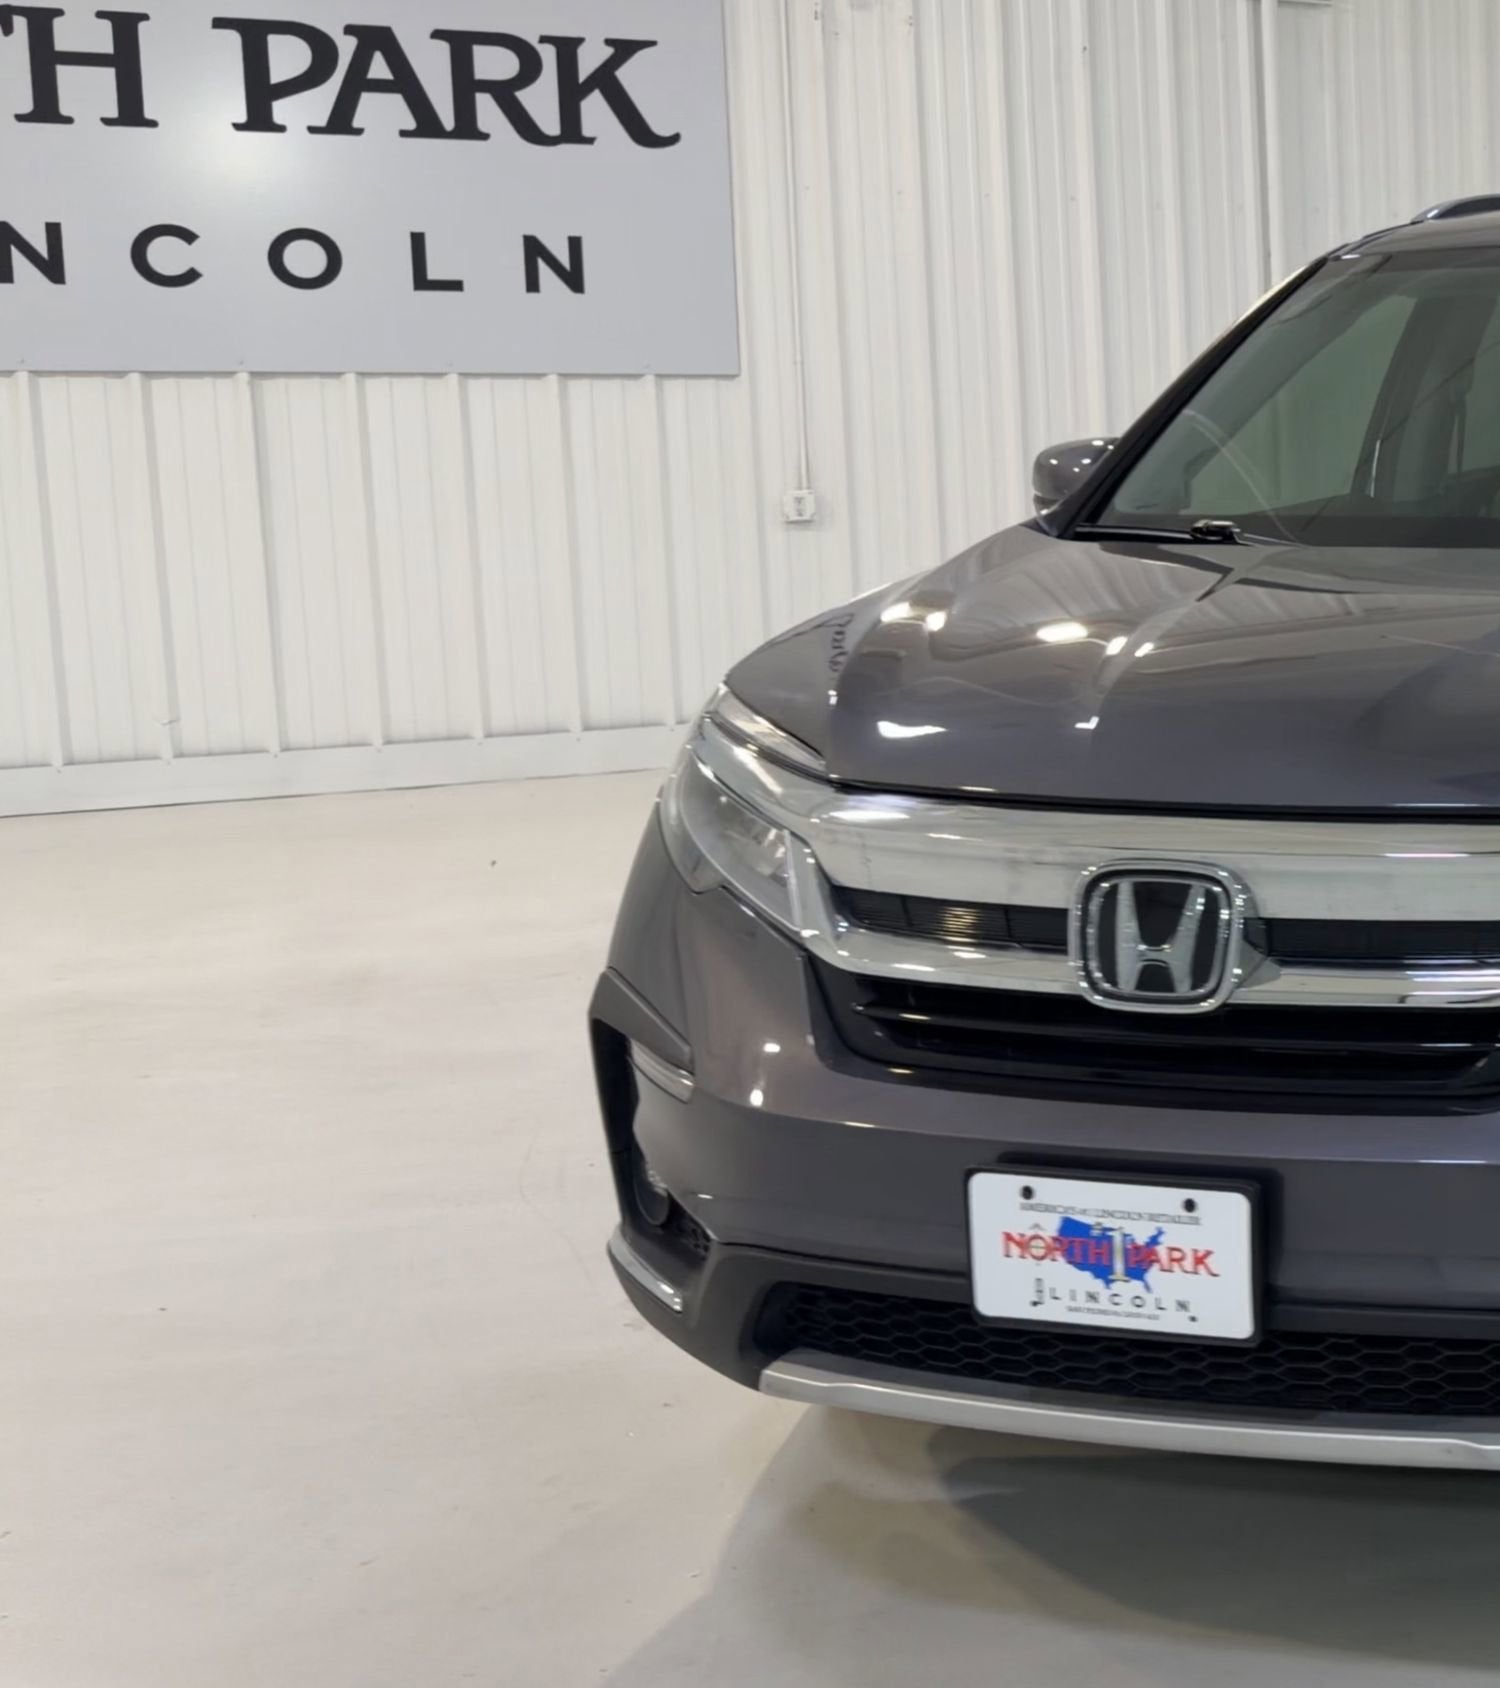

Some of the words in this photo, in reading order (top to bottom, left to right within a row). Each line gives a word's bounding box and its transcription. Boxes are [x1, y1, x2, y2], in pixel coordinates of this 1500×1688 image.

[0, 4, 159, 129] H
[211, 16, 682, 149] PARK
[0, 220, 586, 294] NCOLN
[1001, 1231, 1111, 1266] NORTH
[1127, 1240, 1221, 1277] PARK
[1048, 1286, 1191, 1313] LINCOLN
